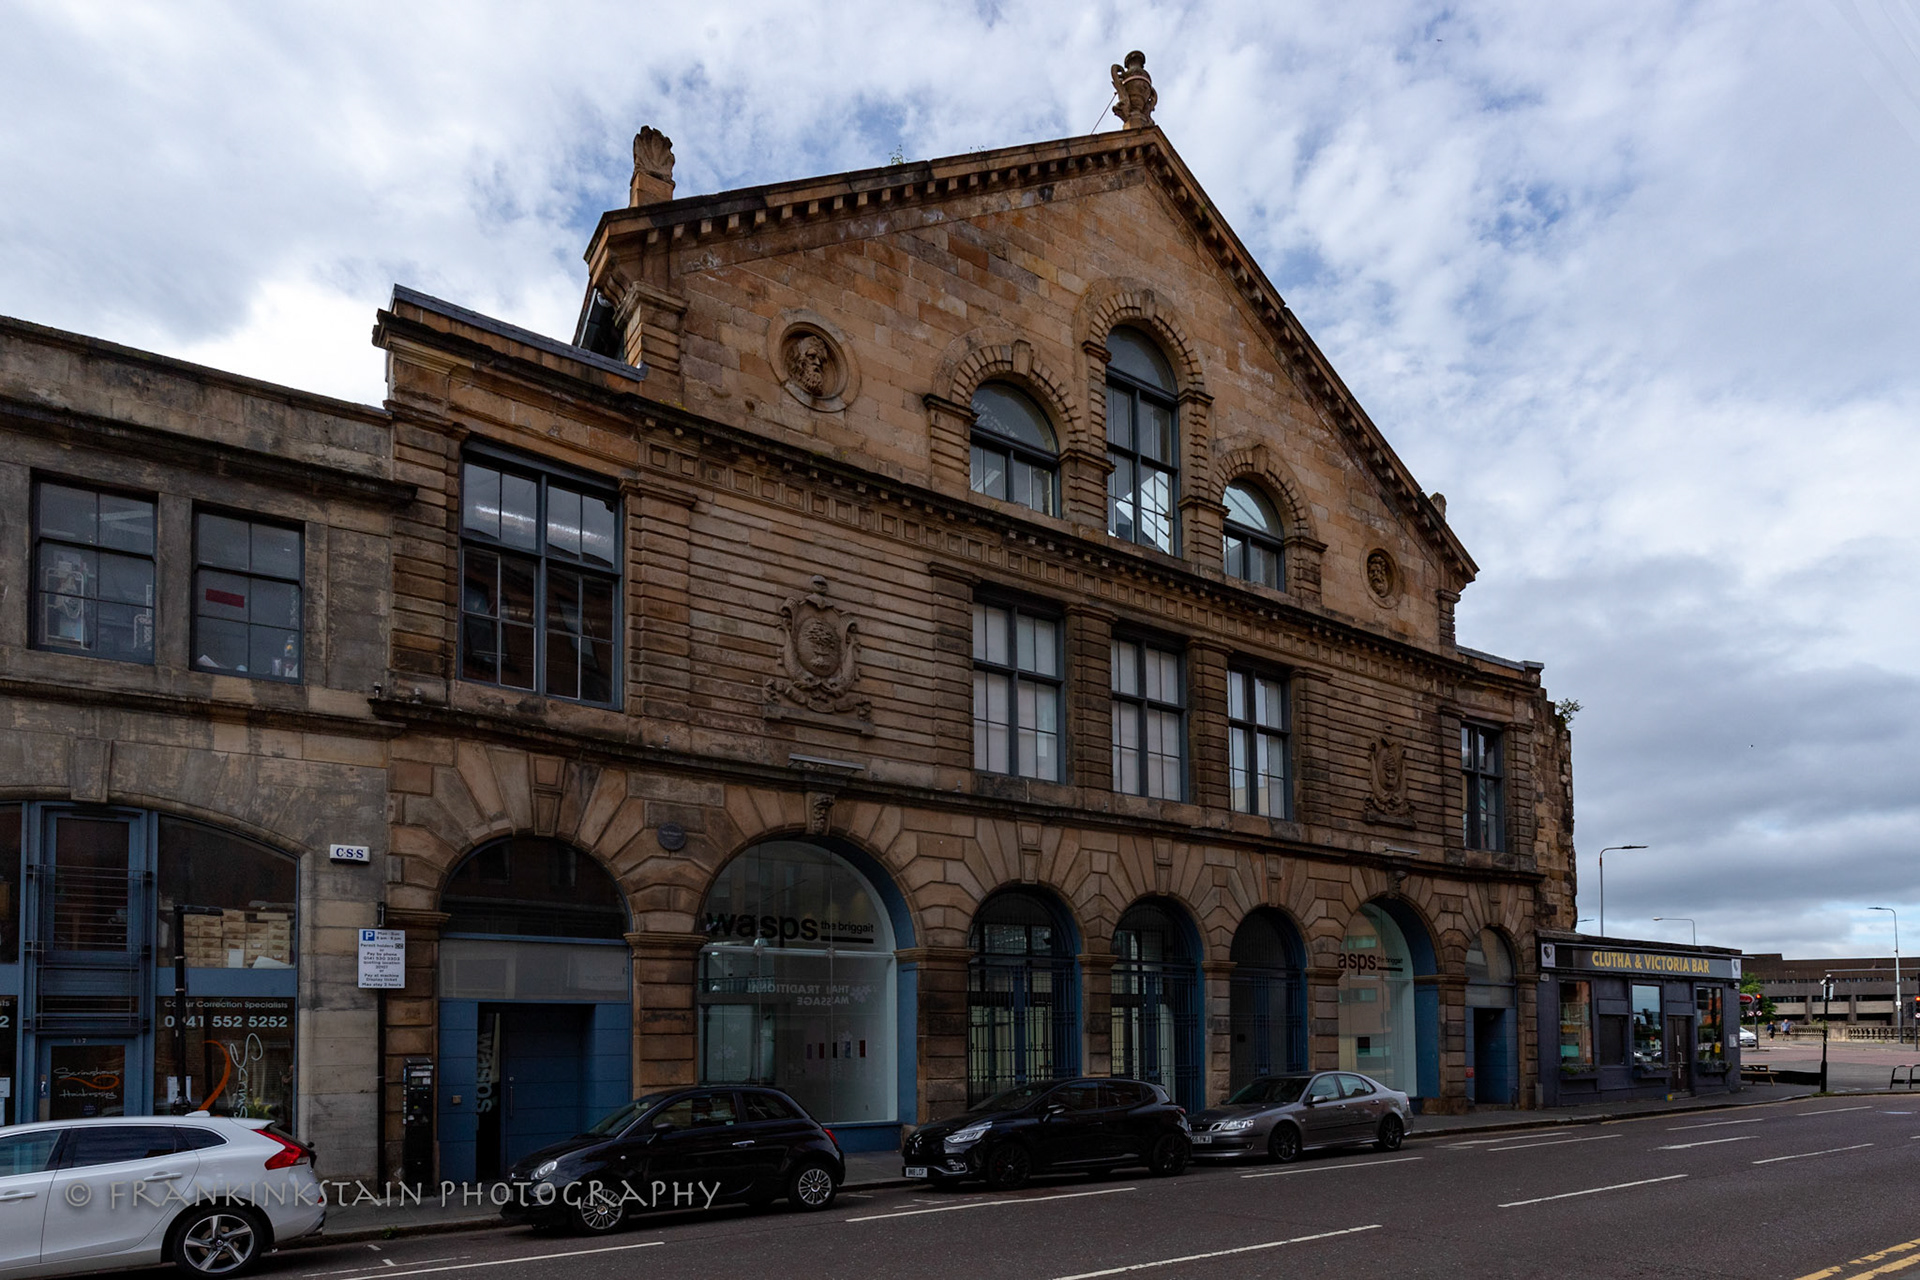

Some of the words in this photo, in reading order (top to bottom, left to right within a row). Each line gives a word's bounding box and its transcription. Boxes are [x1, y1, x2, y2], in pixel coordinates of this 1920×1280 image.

[705, 912, 819, 948] wasps
[820, 920, 836, 931] the
[838, 921, 874, 935] briggait
[1591, 950, 1632, 968] CLUTHA
[1634, 954, 1643, 969] &
[1644, 954, 1690, 972] VICTORIA
[1691, 958, 1710, 974] BAR
[196, 1000, 243, 1008] Correction
[244, 1000, 288, 1010] Specialists
[211, 1015, 243, 1028] 552
[247, 1015, 288, 1028] 5252
